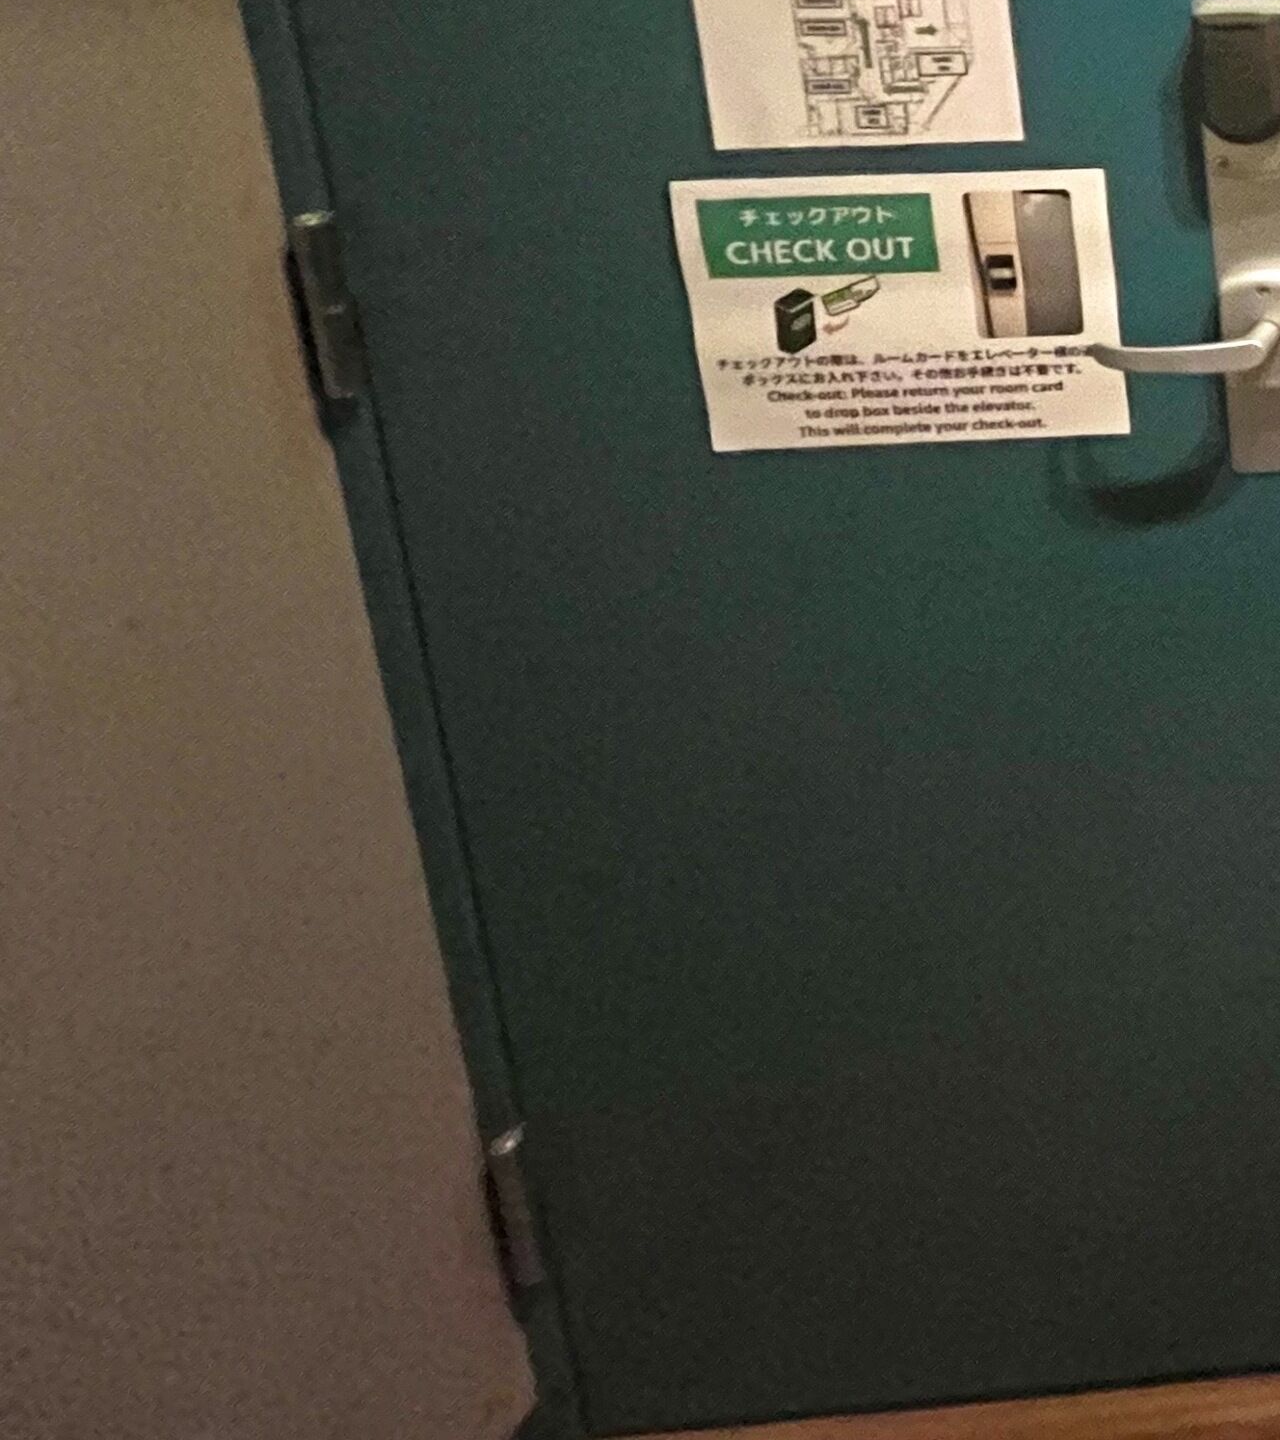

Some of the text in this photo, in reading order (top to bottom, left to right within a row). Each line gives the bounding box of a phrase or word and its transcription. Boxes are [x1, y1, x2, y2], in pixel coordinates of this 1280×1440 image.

[738, 204, 895, 227] チェックアウト
[725, 235, 915, 266] CHECK OUT
[767, 380, 1064, 403] Check-out: Please return your room card
[805, 408, 820, 419] to
[824, 406, 859, 420] drop
[862, 405, 890, 417] box
[892, 403, 941, 416] beside
[945, 402, 969, 414] the
[798, 425, 829, 438] This
[833, 423, 861, 436] will
[864, 421, 932, 436] complete
[935, 422, 968, 435] your
